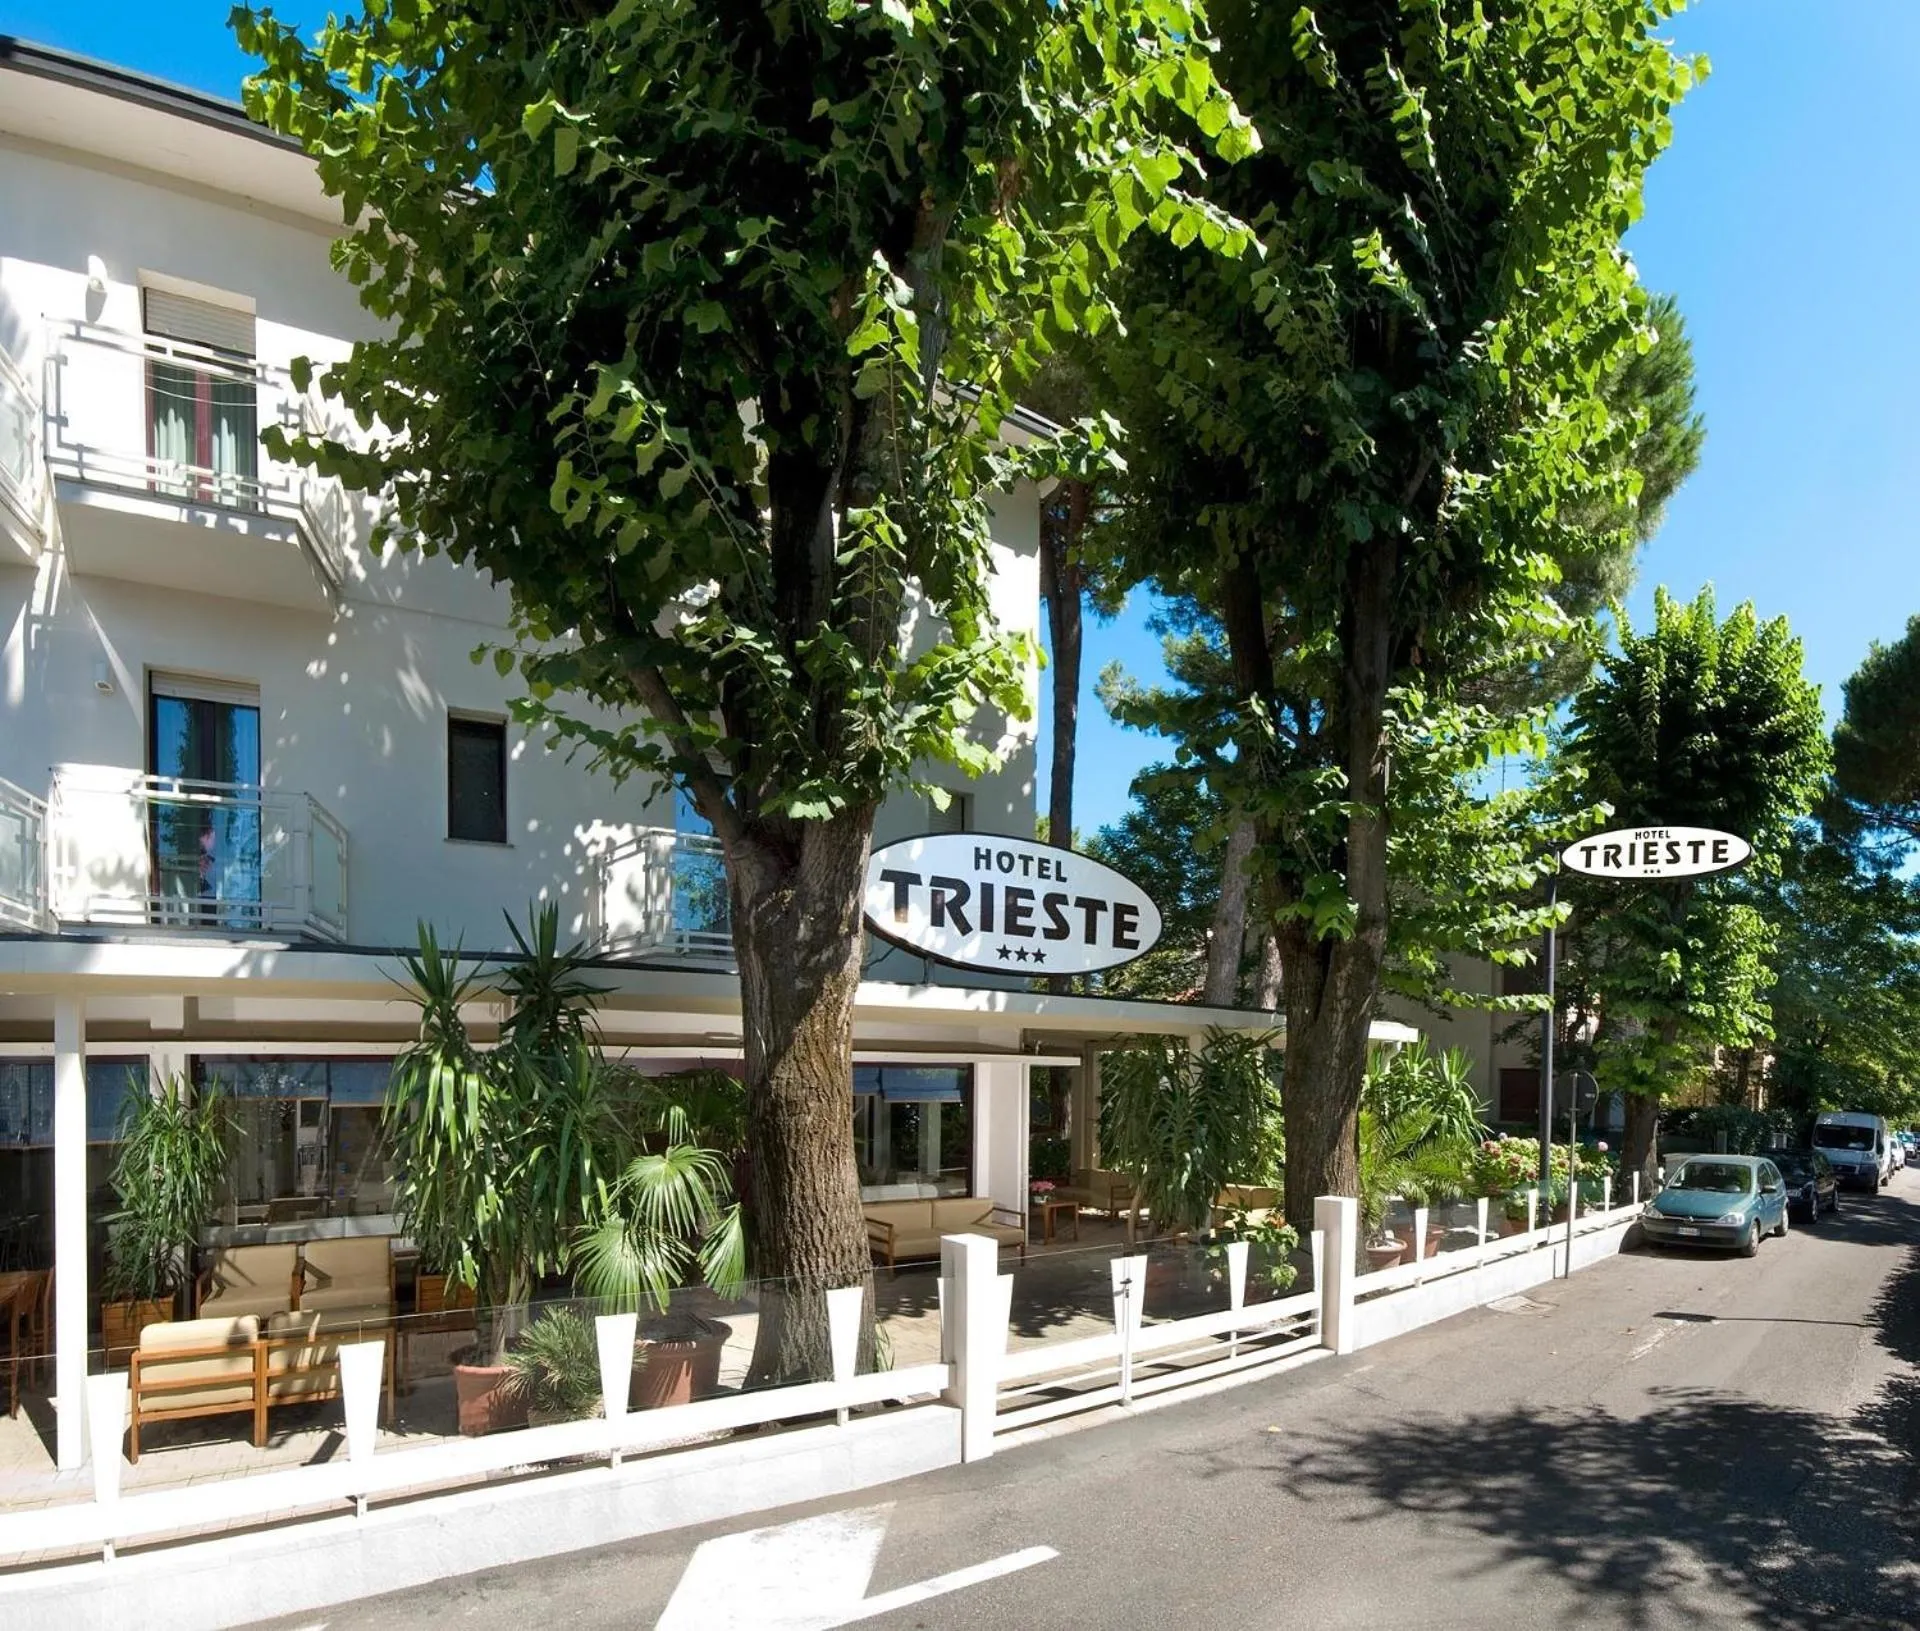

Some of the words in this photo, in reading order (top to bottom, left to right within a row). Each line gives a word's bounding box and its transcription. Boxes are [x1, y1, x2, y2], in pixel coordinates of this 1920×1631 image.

[1635, 830, 1671, 840] HOTEL
[974, 847, 1067, 882] HOTEL
[1580, 839, 1728, 869] TRIESTE
[880, 869, 1140, 950] TRIESTE
